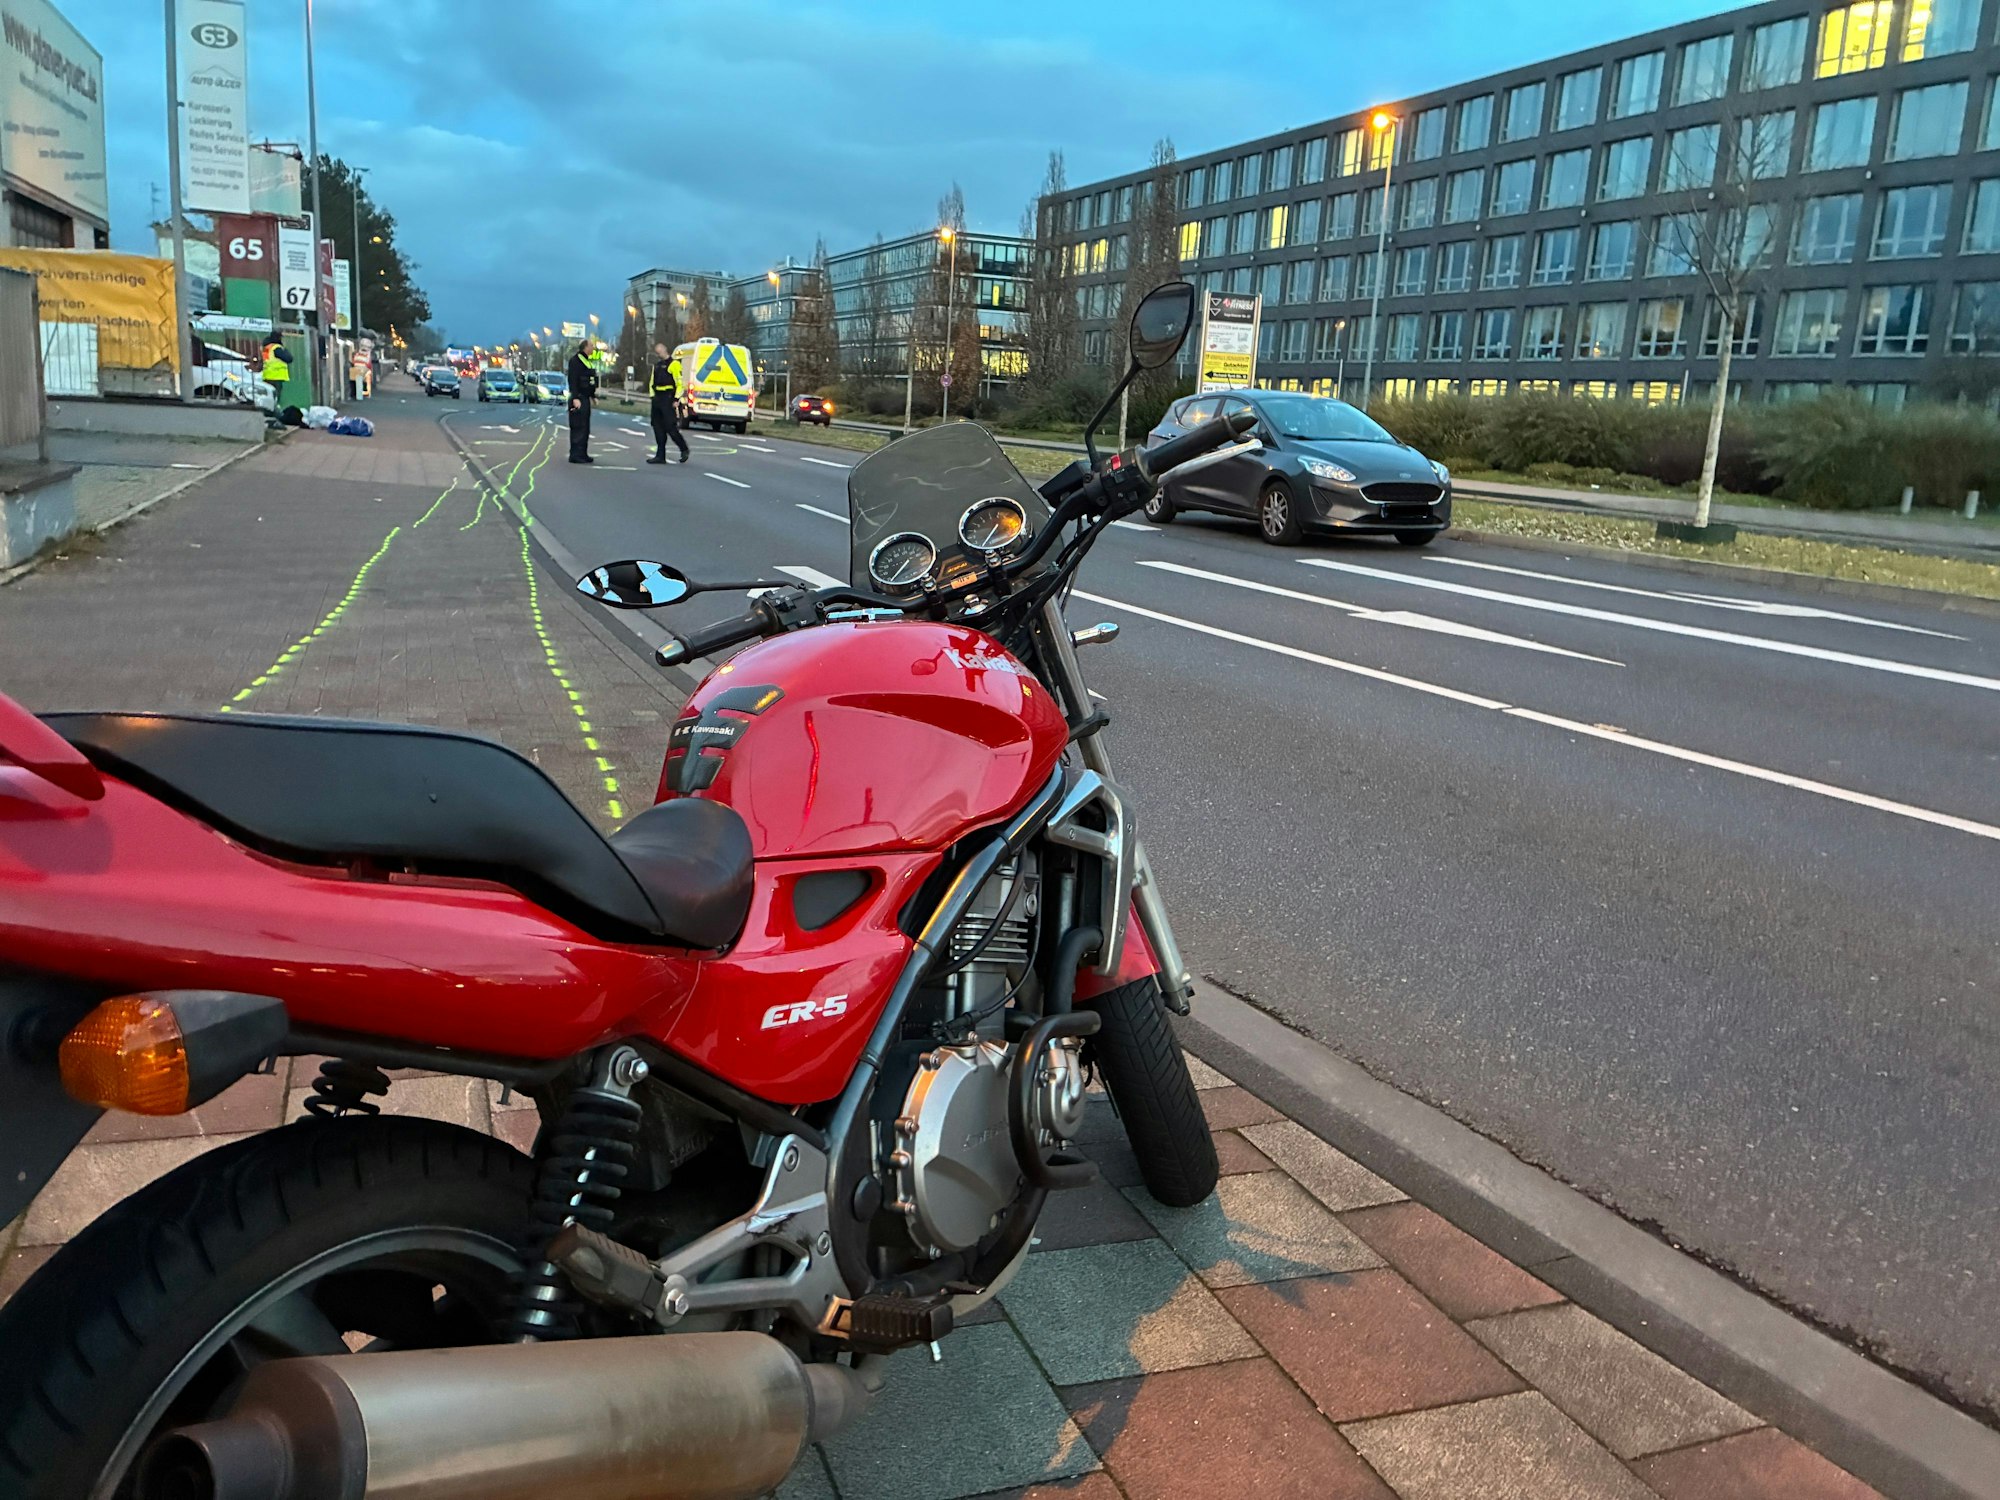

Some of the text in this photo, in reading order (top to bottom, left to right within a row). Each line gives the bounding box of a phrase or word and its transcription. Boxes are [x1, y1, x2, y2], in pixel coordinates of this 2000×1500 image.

[200, 25, 229, 47] 63
[191, 76, 214, 87] AUTO
[188, 101, 231, 114] Karosserie
[189, 116, 232, 130] Lackierung
[215, 132, 245, 144] Service
[214, 145, 243, 157] Service
[229, 237, 264, 260] 65
[286, 287, 310, 306] 67
[691, 725, 735, 736] Kawasaki
[761, 994, 848, 1030] ER-5
